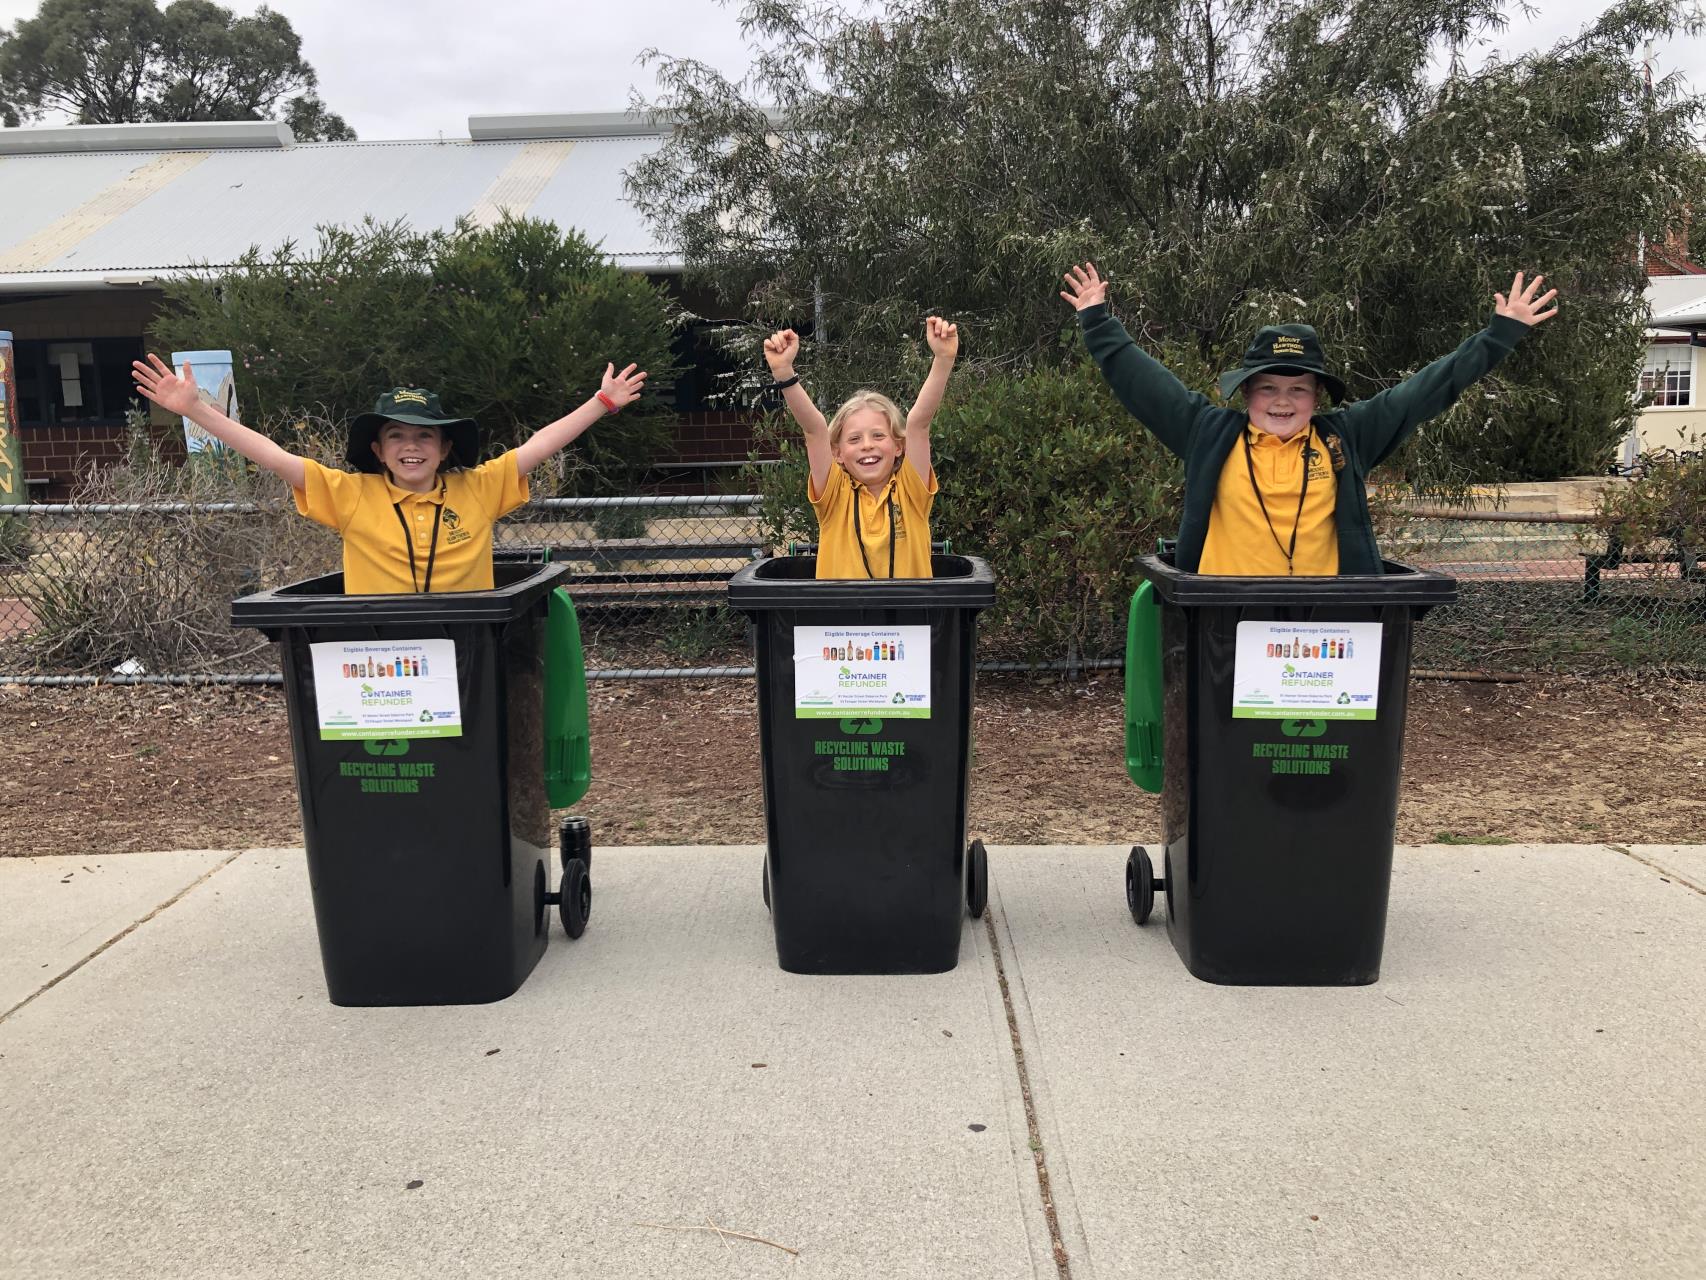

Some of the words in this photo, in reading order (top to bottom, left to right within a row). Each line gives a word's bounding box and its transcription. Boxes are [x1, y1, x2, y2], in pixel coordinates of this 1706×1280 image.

[838, 680, 887, 688] REFUNDER
[1281, 679, 1334, 687] REFUNDER
[361, 697, 413, 706] REFUNDER
[814, 741, 869, 755] RECYCLING
[871, 742, 905, 755] WASTE
[1252, 743, 1310, 758] RECYCLING
[1312, 744, 1349, 759] WASTE
[339, 762, 397, 777] RECYCLING
[398, 763, 435, 777] WASTE
[833, 756, 889, 771] SOLUTIONS
[1271, 760, 1331, 774] SOLUTIONS
[361, 778, 419, 793] SOLUTIONS
